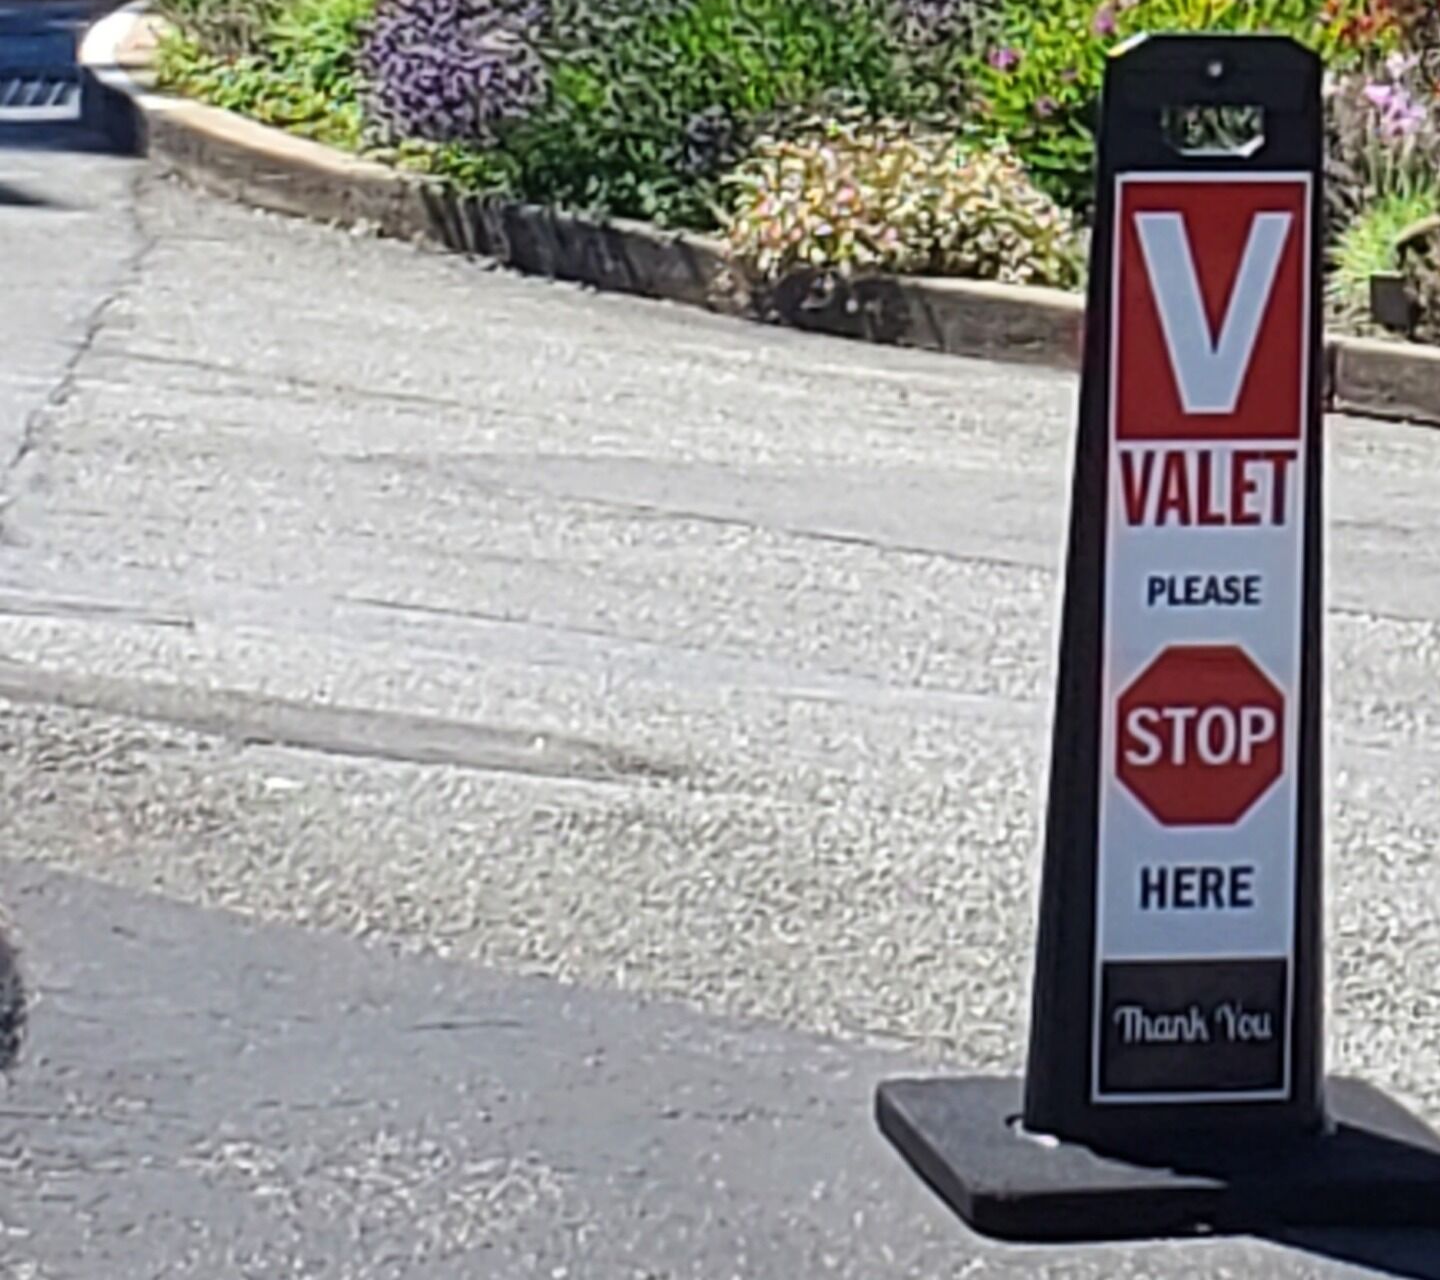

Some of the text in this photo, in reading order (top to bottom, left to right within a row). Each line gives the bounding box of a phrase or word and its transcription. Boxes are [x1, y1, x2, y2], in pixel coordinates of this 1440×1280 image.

[1133, 211, 1293, 414] V
[1119, 450, 1298, 527] VALET
[1147, 576, 1262, 607] PLEASE
[1124, 706, 1277, 767] STOP
[1139, 866, 1255, 910] HERE
[1114, 1002, 1272, 1042] Thank You
